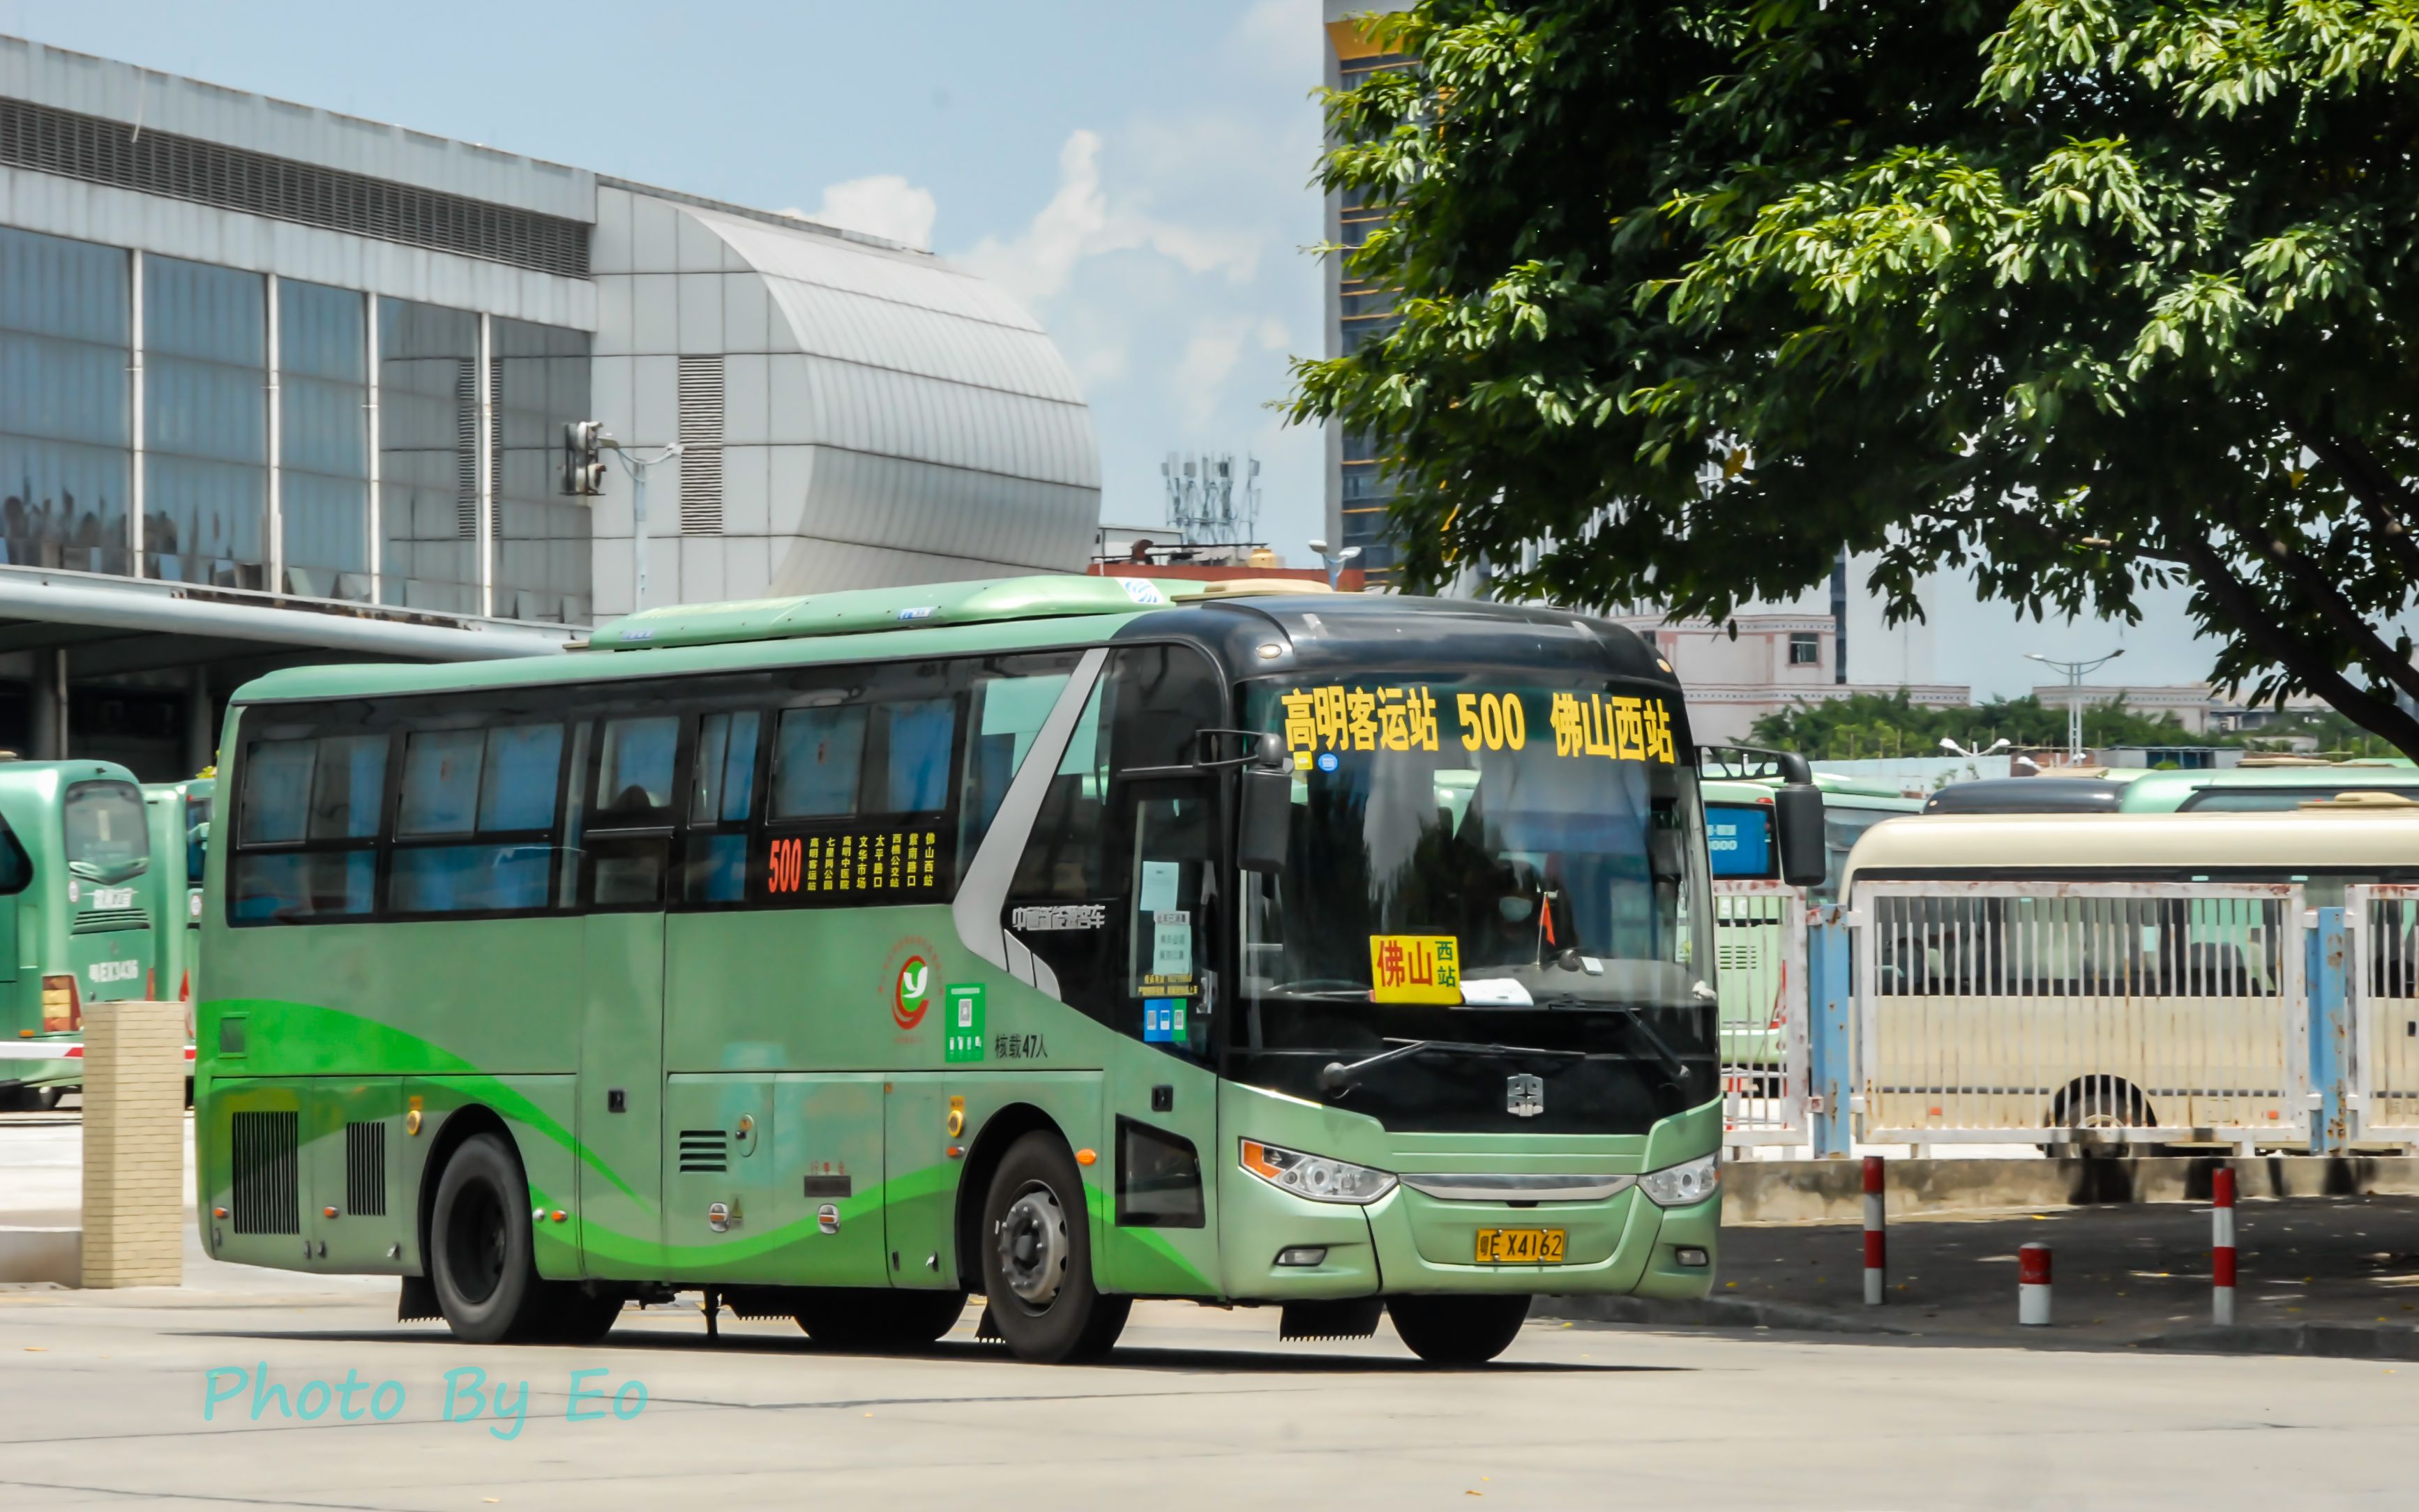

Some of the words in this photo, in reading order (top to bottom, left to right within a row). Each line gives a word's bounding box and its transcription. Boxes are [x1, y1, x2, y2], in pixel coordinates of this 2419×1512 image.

[1281, 686, 1439, 751] 高明客运站
[1456, 693, 1525, 751] 500
[1550, 692, 1675, 764] 佛山西站
[768, 838, 802, 893] 500
[856, 836, 869, 889] 文华市场
[923, 831, 935, 886] 佛山西站
[1377, 939, 1433, 988] 佛山
[994, 1033, 1048, 1059] 核载47人
